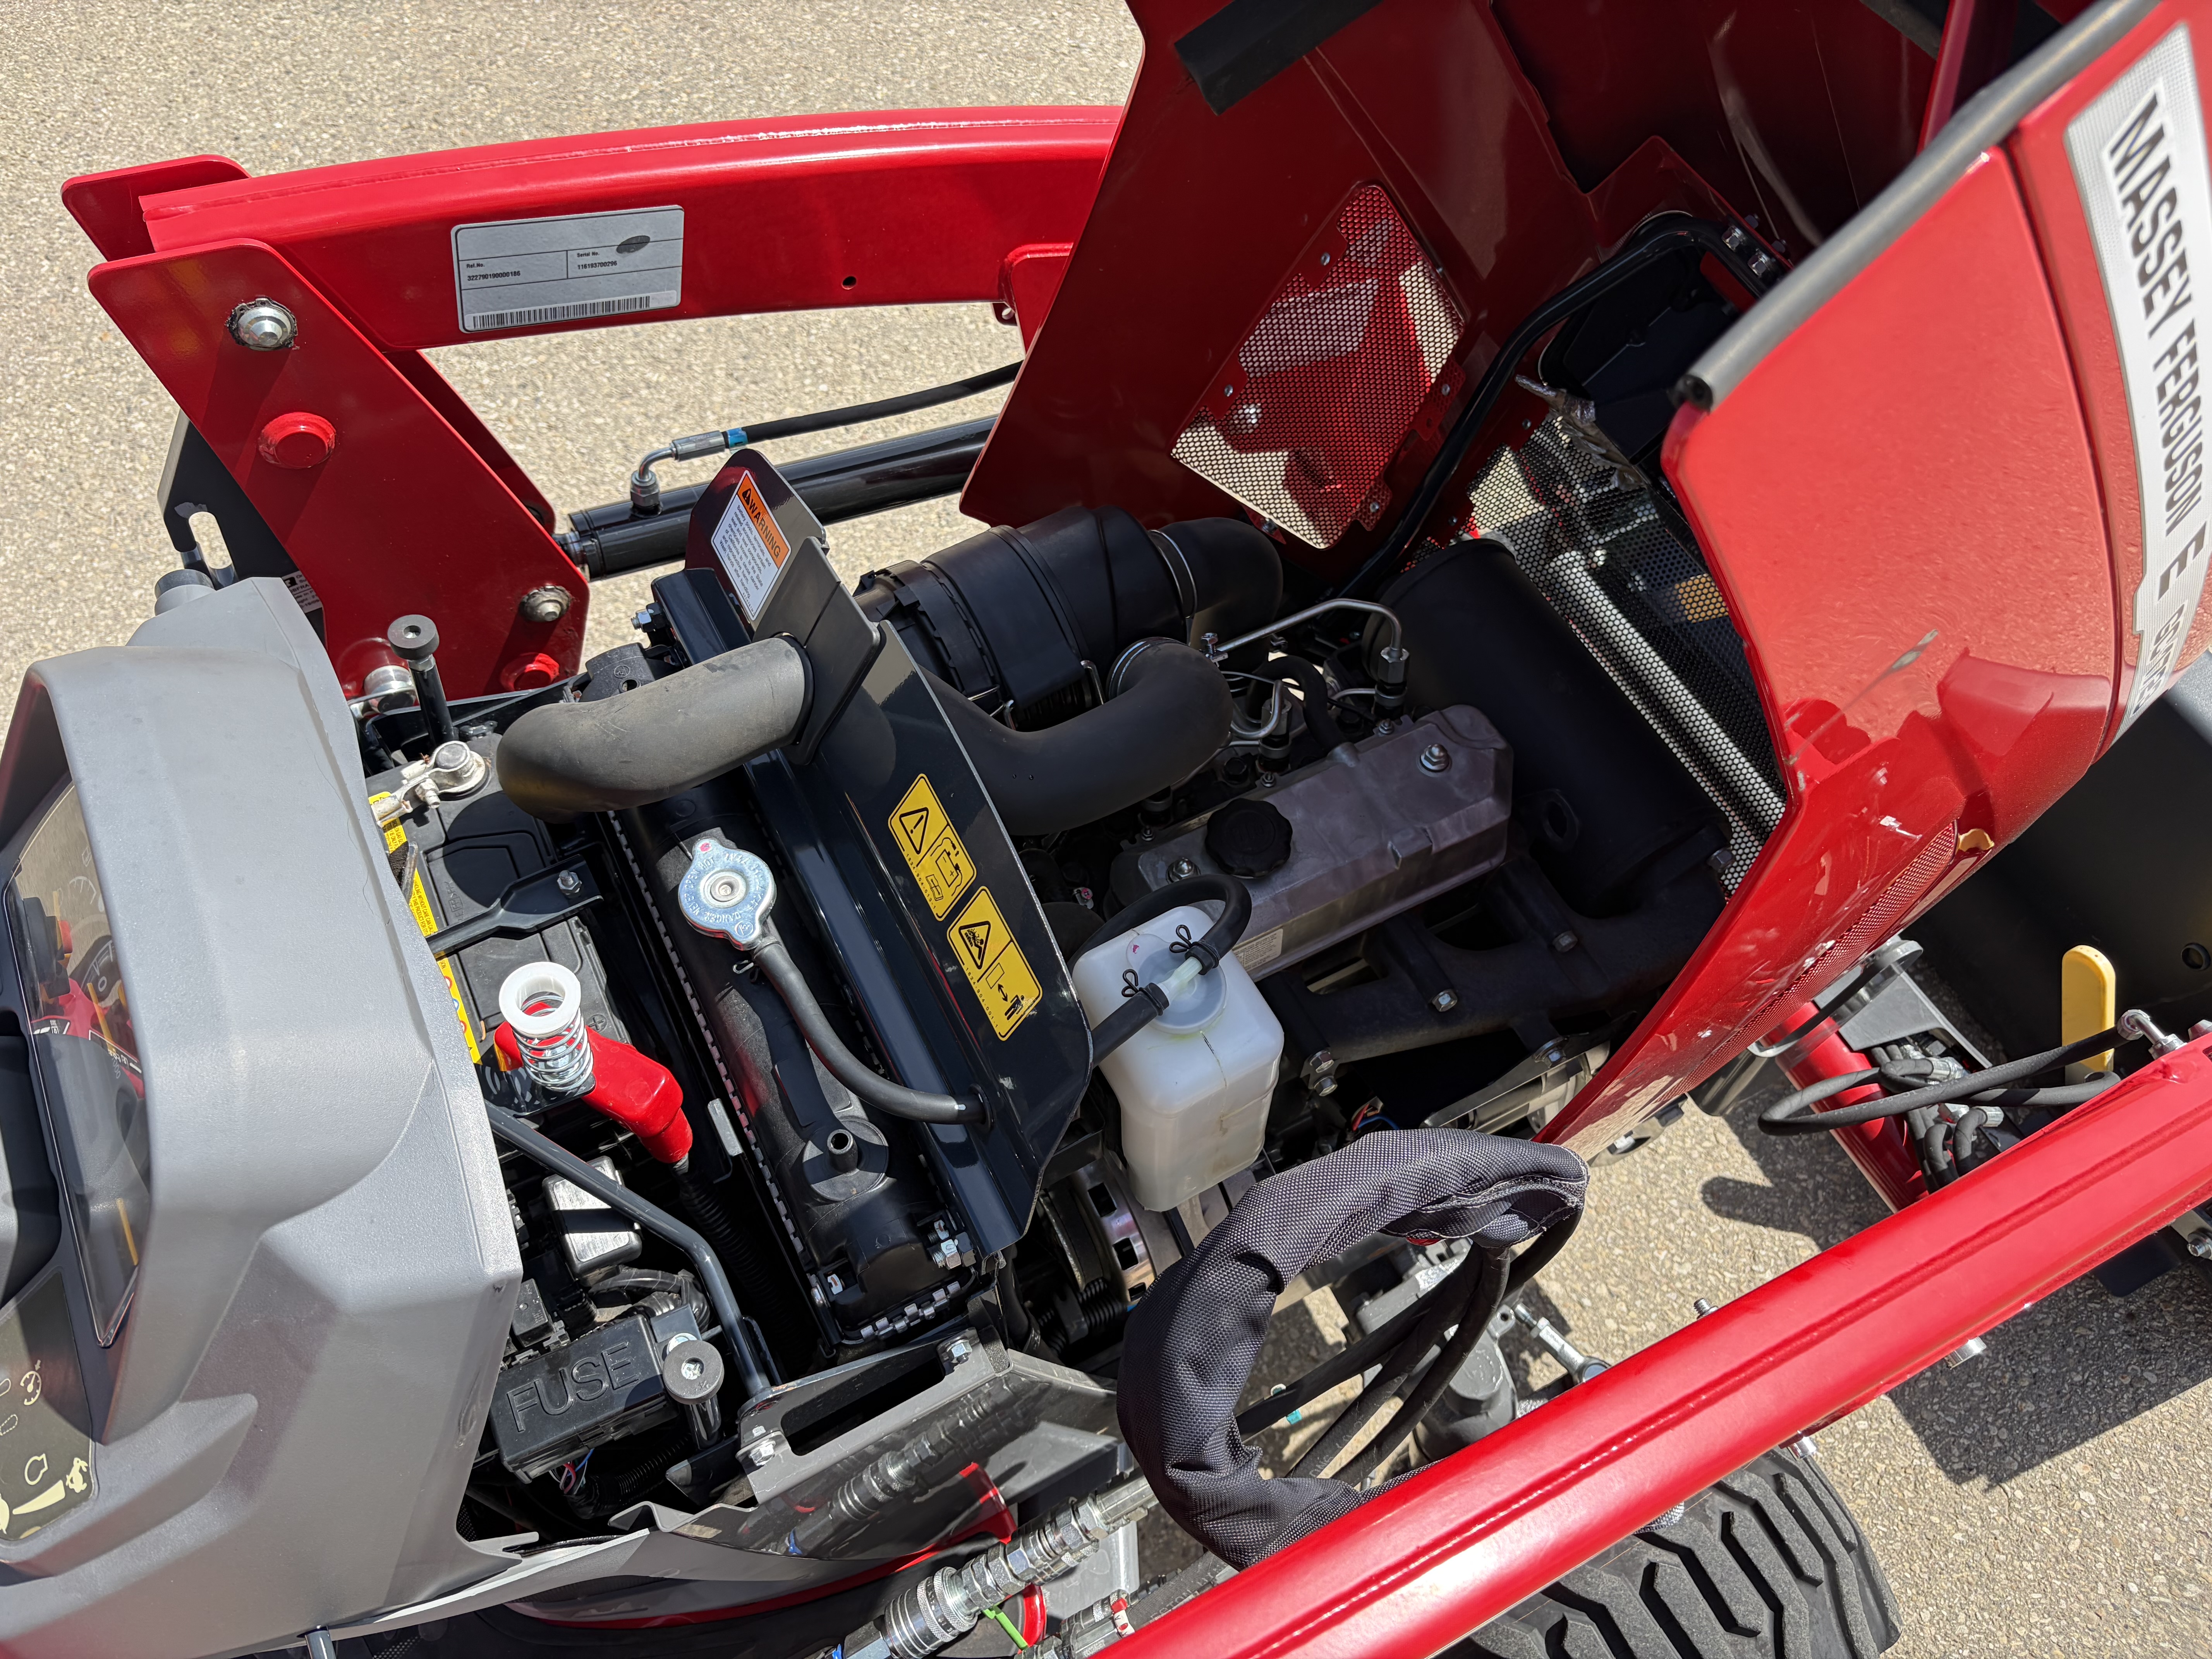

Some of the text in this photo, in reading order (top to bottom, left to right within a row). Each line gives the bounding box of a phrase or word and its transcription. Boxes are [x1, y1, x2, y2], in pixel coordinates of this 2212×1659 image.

[467, 270, 521, 282] 322790190000186
[577, 261, 618, 270] 116193700296
[2109, 91, 2203, 538] MASSEY FERGUSON
[747, 498, 781, 560] WARNING
[507, 1341, 639, 1432] FUSE
